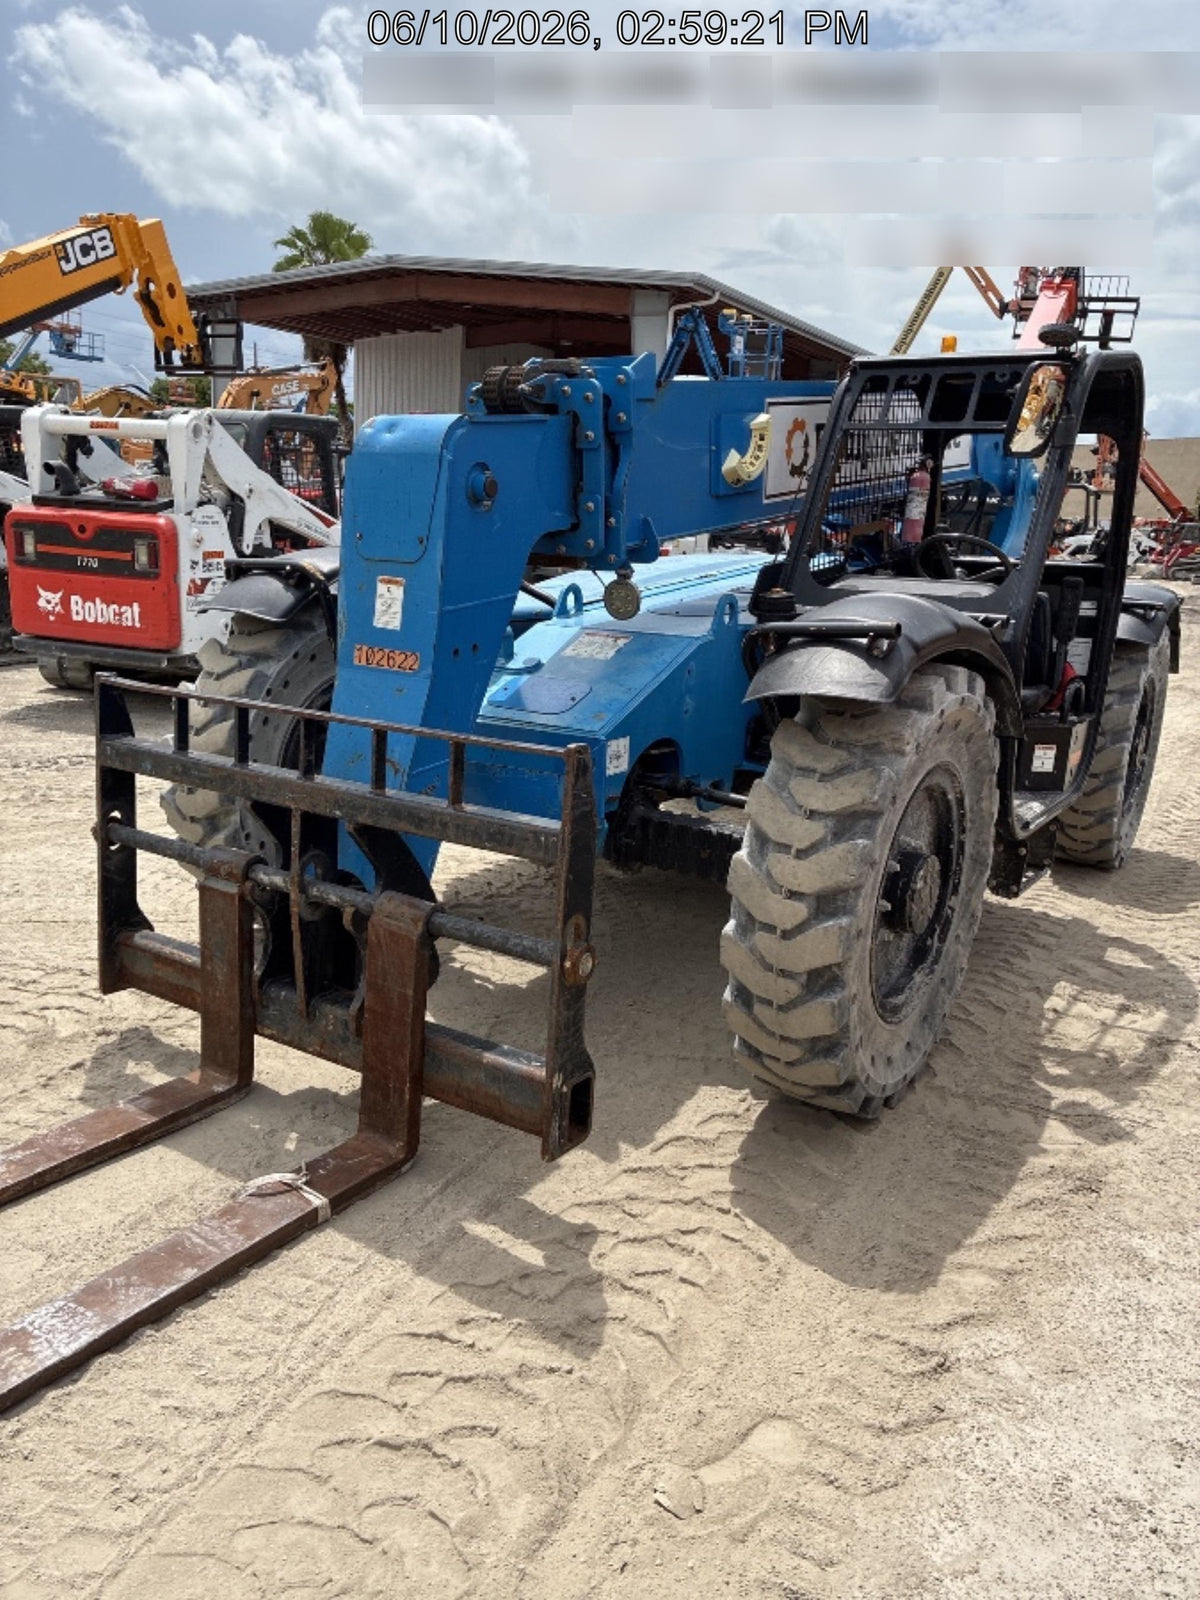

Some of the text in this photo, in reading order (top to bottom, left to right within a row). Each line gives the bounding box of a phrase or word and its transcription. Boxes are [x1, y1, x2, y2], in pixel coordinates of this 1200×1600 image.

[59, 228, 115, 273] JCB
[271, 379, 300, 396] CASE
[76, 556, 99, 568] T770
[70, 594, 141, 628] Bobcat
[354, 644, 419, 671] 102622
